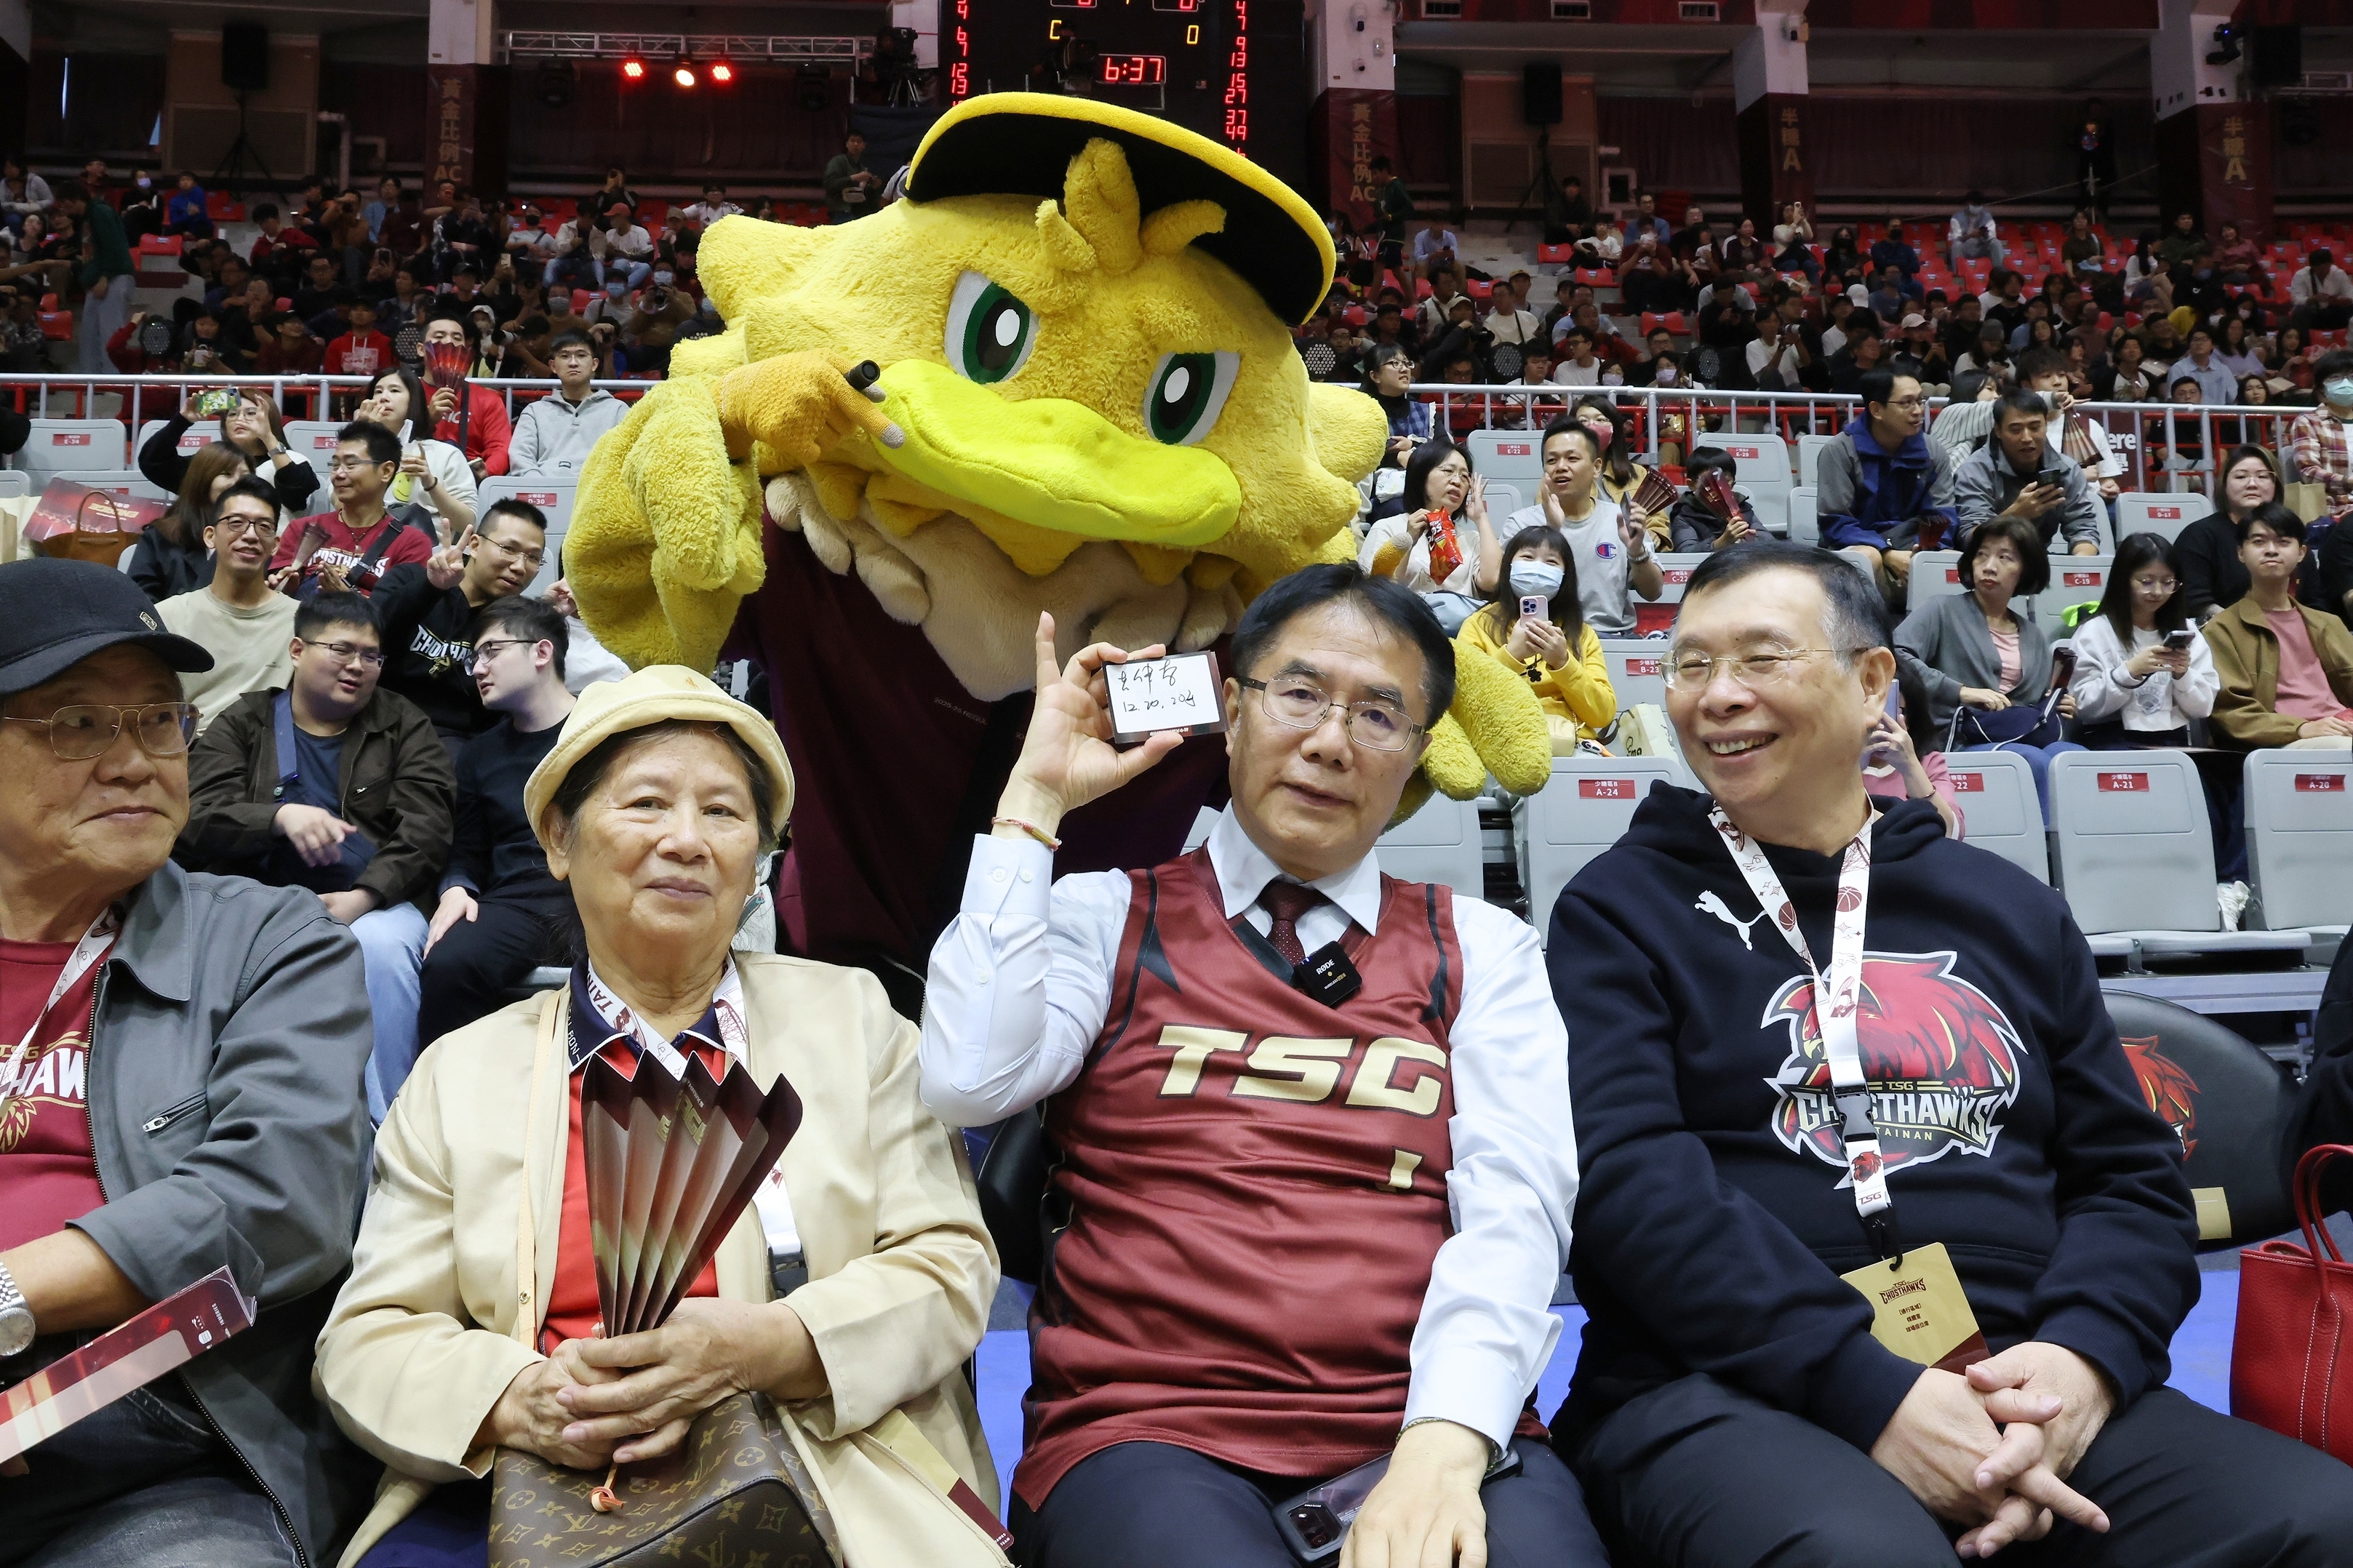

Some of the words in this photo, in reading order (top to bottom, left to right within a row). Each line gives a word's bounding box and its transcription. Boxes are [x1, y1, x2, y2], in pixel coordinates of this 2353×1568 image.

[957, 4, 967, 20] 4
[1237, 15, 1246, 30] 7
[956, 25, 967, 41] 6
[1186, 25, 1199, 44] 0
[959, 41, 967, 56] 7
[1236, 36, 1246, 51] 9
[1231, 52, 1246, 67] 13
[951, 63, 967, 79] 12
[1105, 57, 1162, 81] 6:37
[951, 79, 967, 95] 13
[1231, 73, 1246, 88] 15
[1225, 88, 1247, 103] 27
[1226, 109, 1247, 124] 37
[1226, 125, 1247, 140] 49
[1596, 788, 1618, 796] A-24
[2113, 781, 2133, 789] A-21
[2309, 781, 2330, 789] A-20
[1316, 959, 1335, 975] RØDE
[1154, 1023, 1447, 1118] TSG
[1885, 1081, 1914, 1091] TSG
[1790, 1091, 2001, 1148] GHSTHAWKS
[1858, 1191, 1882, 1205] TSG
[1878, 1277, 1927, 1305] GHOSTHAWKS
[1893, 1280, 1906, 1288] TSG
